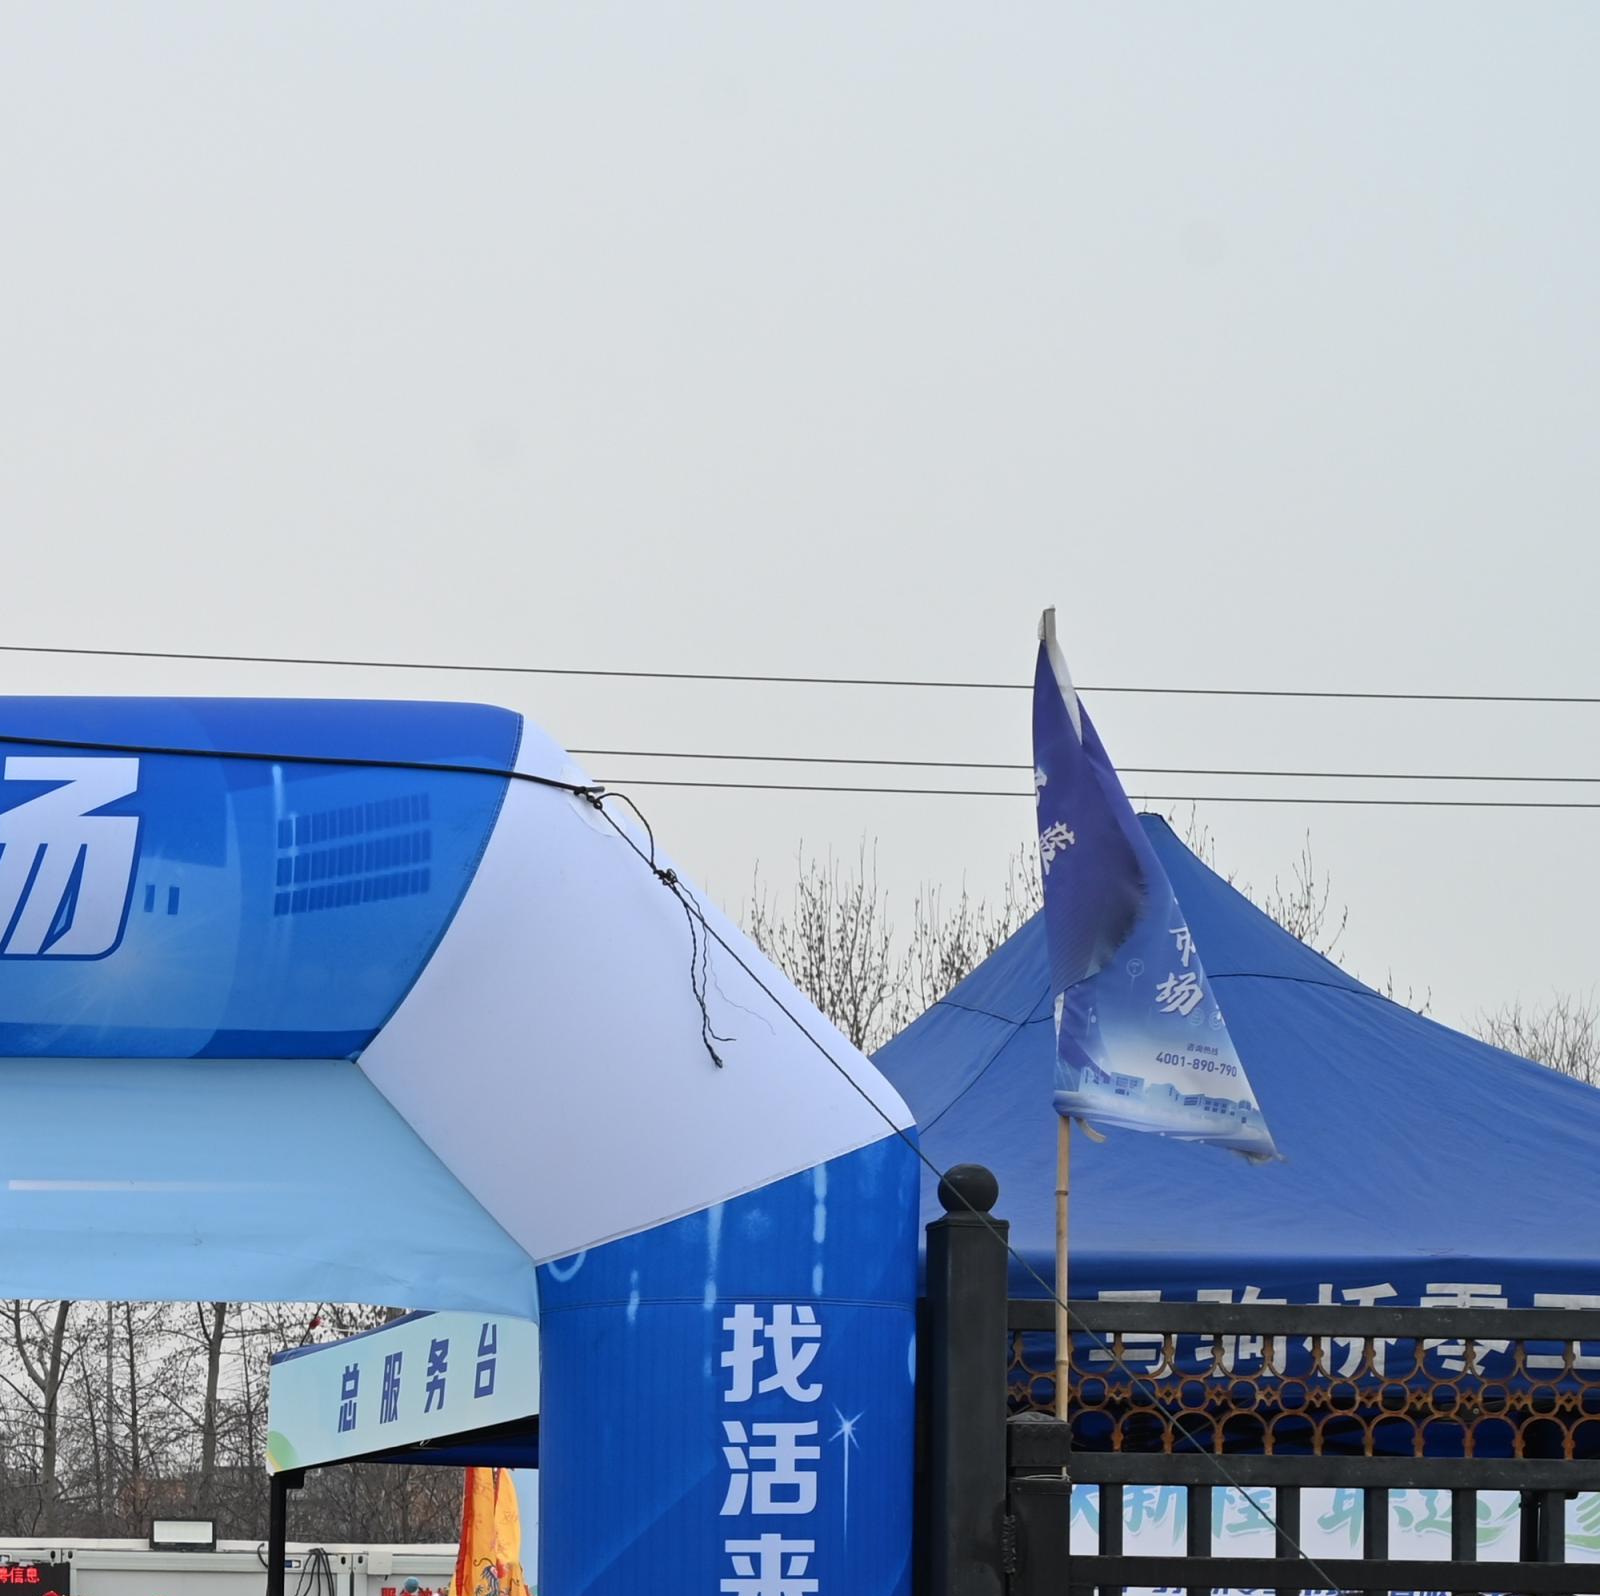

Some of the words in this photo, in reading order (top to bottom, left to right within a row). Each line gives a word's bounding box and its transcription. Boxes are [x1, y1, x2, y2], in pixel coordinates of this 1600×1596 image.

[1155, 1051, 1238, 1078] 4001-890-790
[337, 1322, 499, 1434] 总服务台
